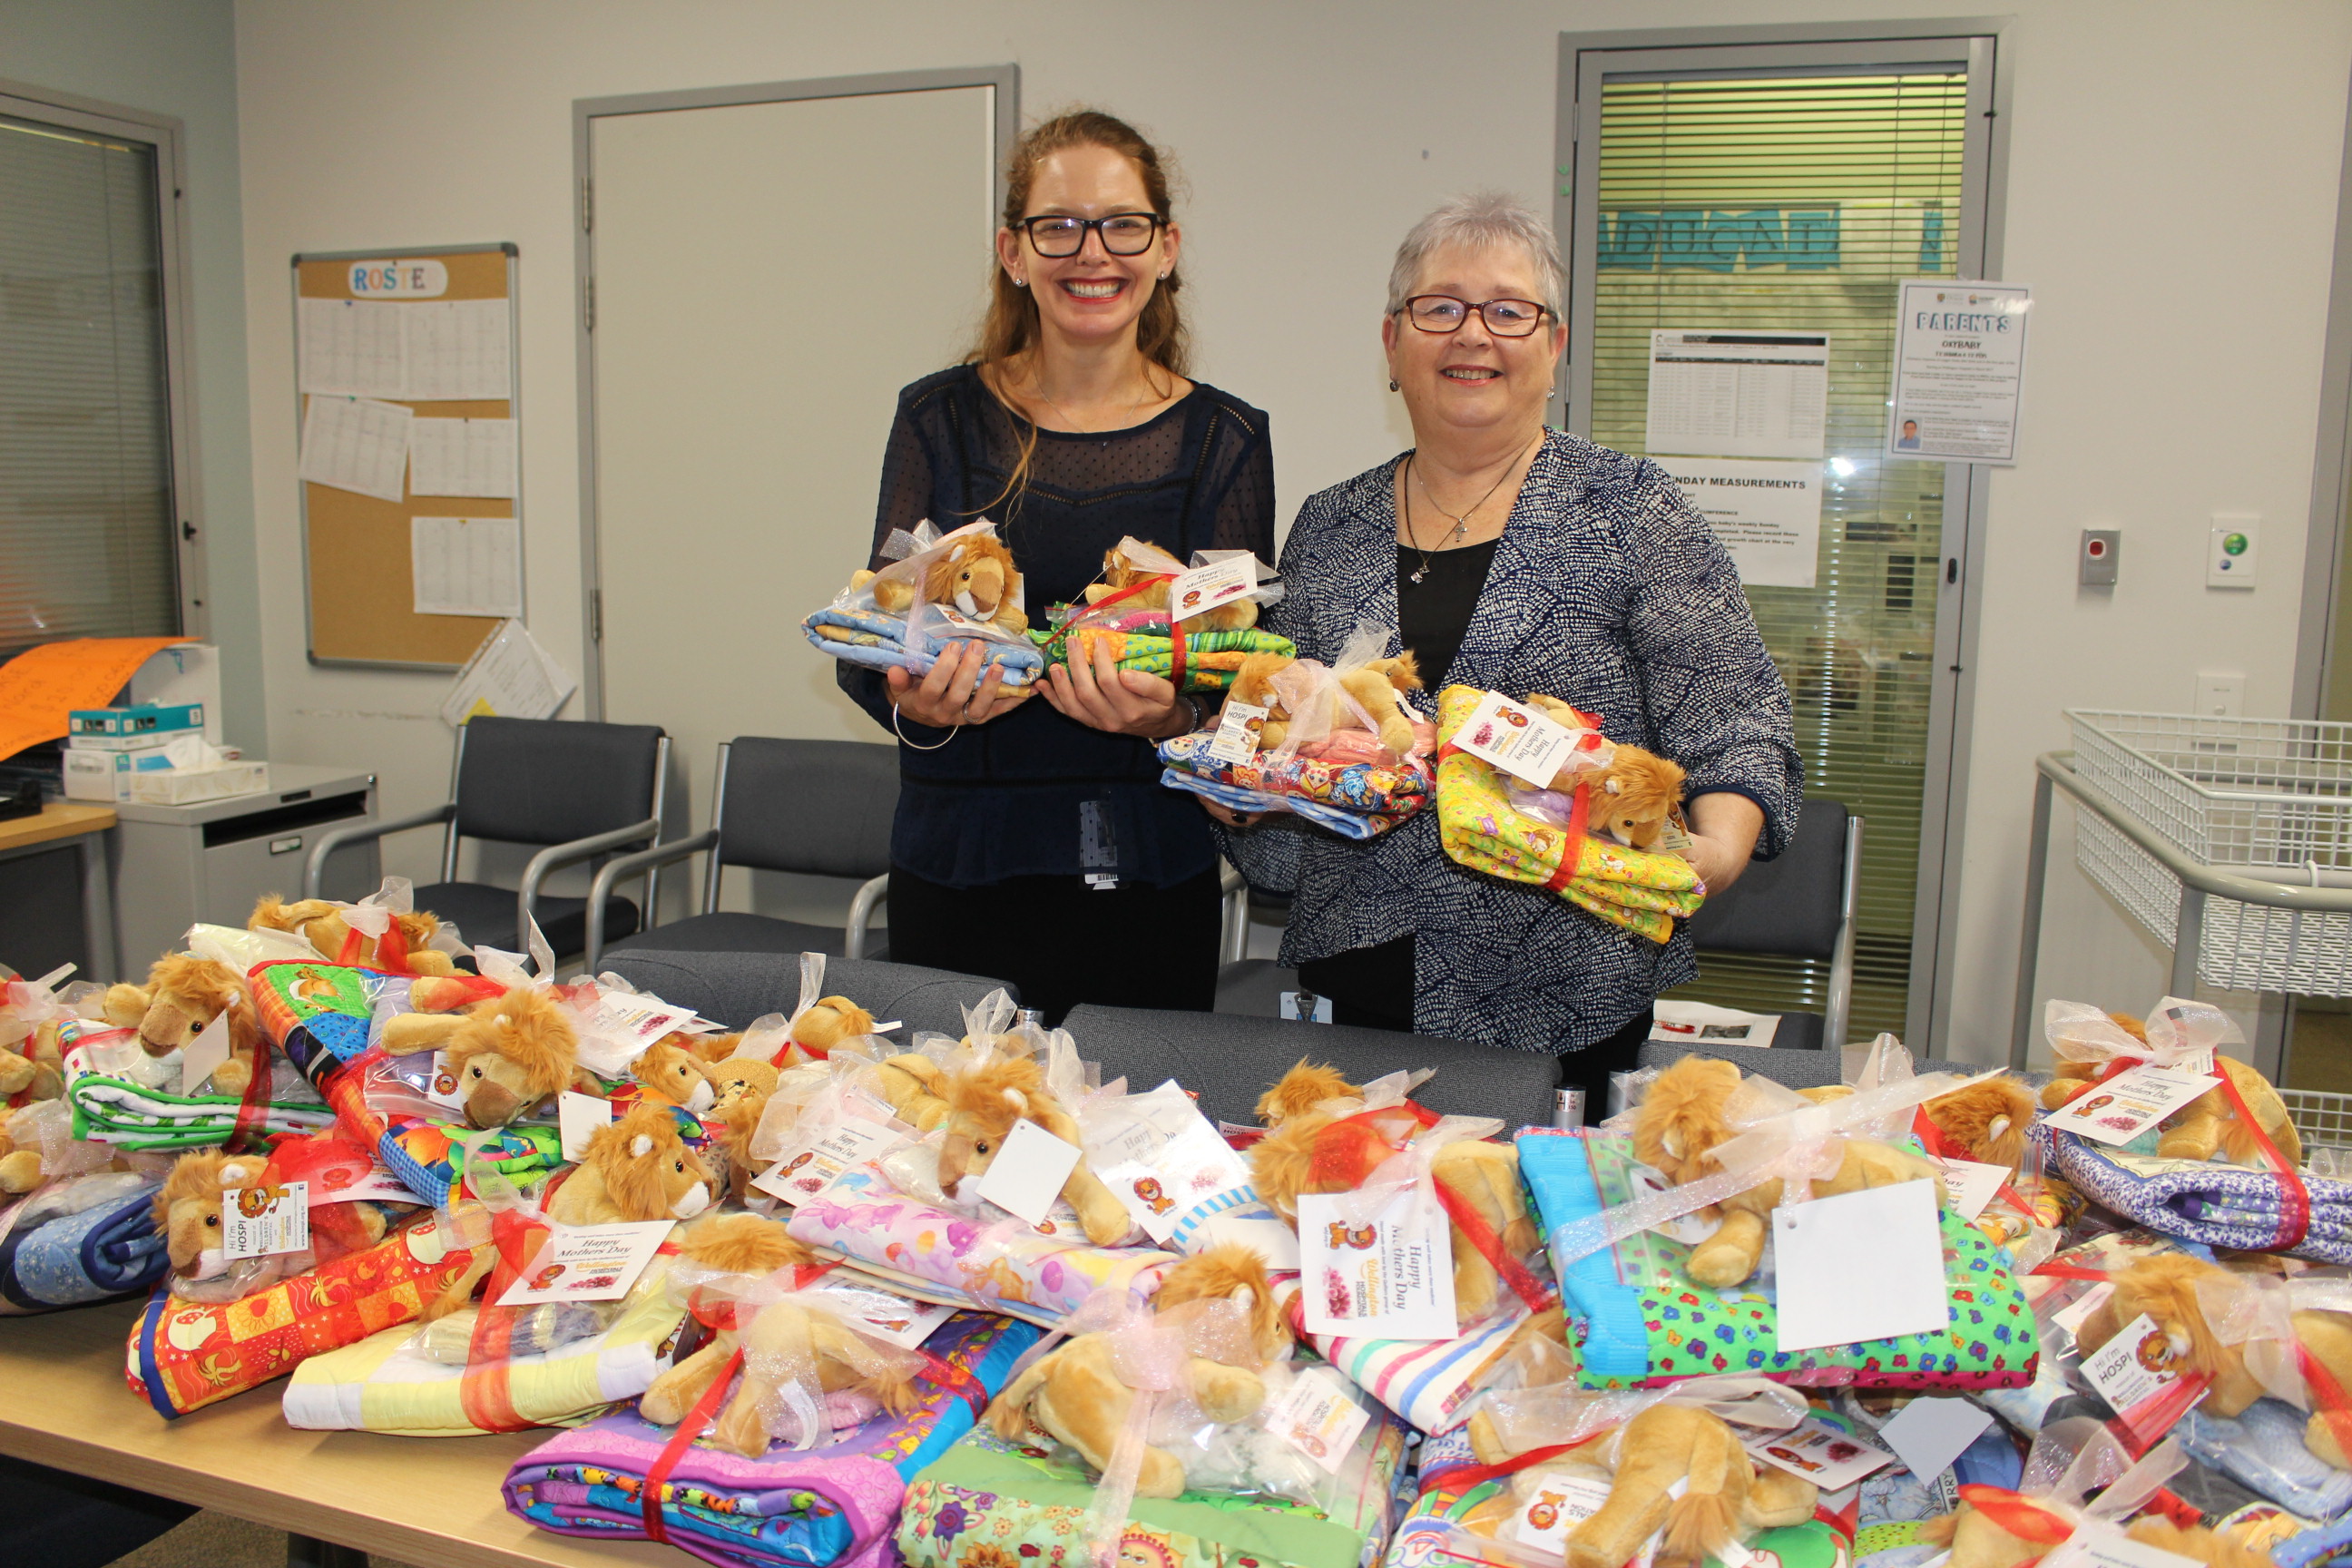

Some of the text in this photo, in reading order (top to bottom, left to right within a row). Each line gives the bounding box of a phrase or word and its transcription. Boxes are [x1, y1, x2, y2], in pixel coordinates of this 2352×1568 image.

[355, 268, 426, 290] ROSTE
[1916, 312, 2011, 333] PARENTS
[1673, 476, 1806, 489] NDAY MEASUREMENTS
[1228, 711, 1248, 720] HOSPI
[1525, 726, 1545, 749] Mothers
[1515, 748, 1531, 761] Day
[1531, 740, 1550, 758] Happy
[2118, 1083, 2151, 1095] Mothers
[2141, 1080, 2171, 1091] Happy
[838, 1133, 858, 1146] Happy
[1124, 1130, 1152, 1150] Happ
[841, 1147, 857, 1159] Day
[228, 1240, 236, 1249] Hi
[236, 1220, 248, 1251] HOSPI
[582, 1239, 621, 1248] Happy
[557, 1246, 632, 1258] Mothers Day
[1406, 1245, 1423, 1289] Happy
[1365, 1259, 1379, 1317] Wellington
[1392, 1283, 1407, 1309] Day
[2094, 1348, 2120, 1370] Hi I'm
[2099, 1351, 2132, 1384] HOSPI
